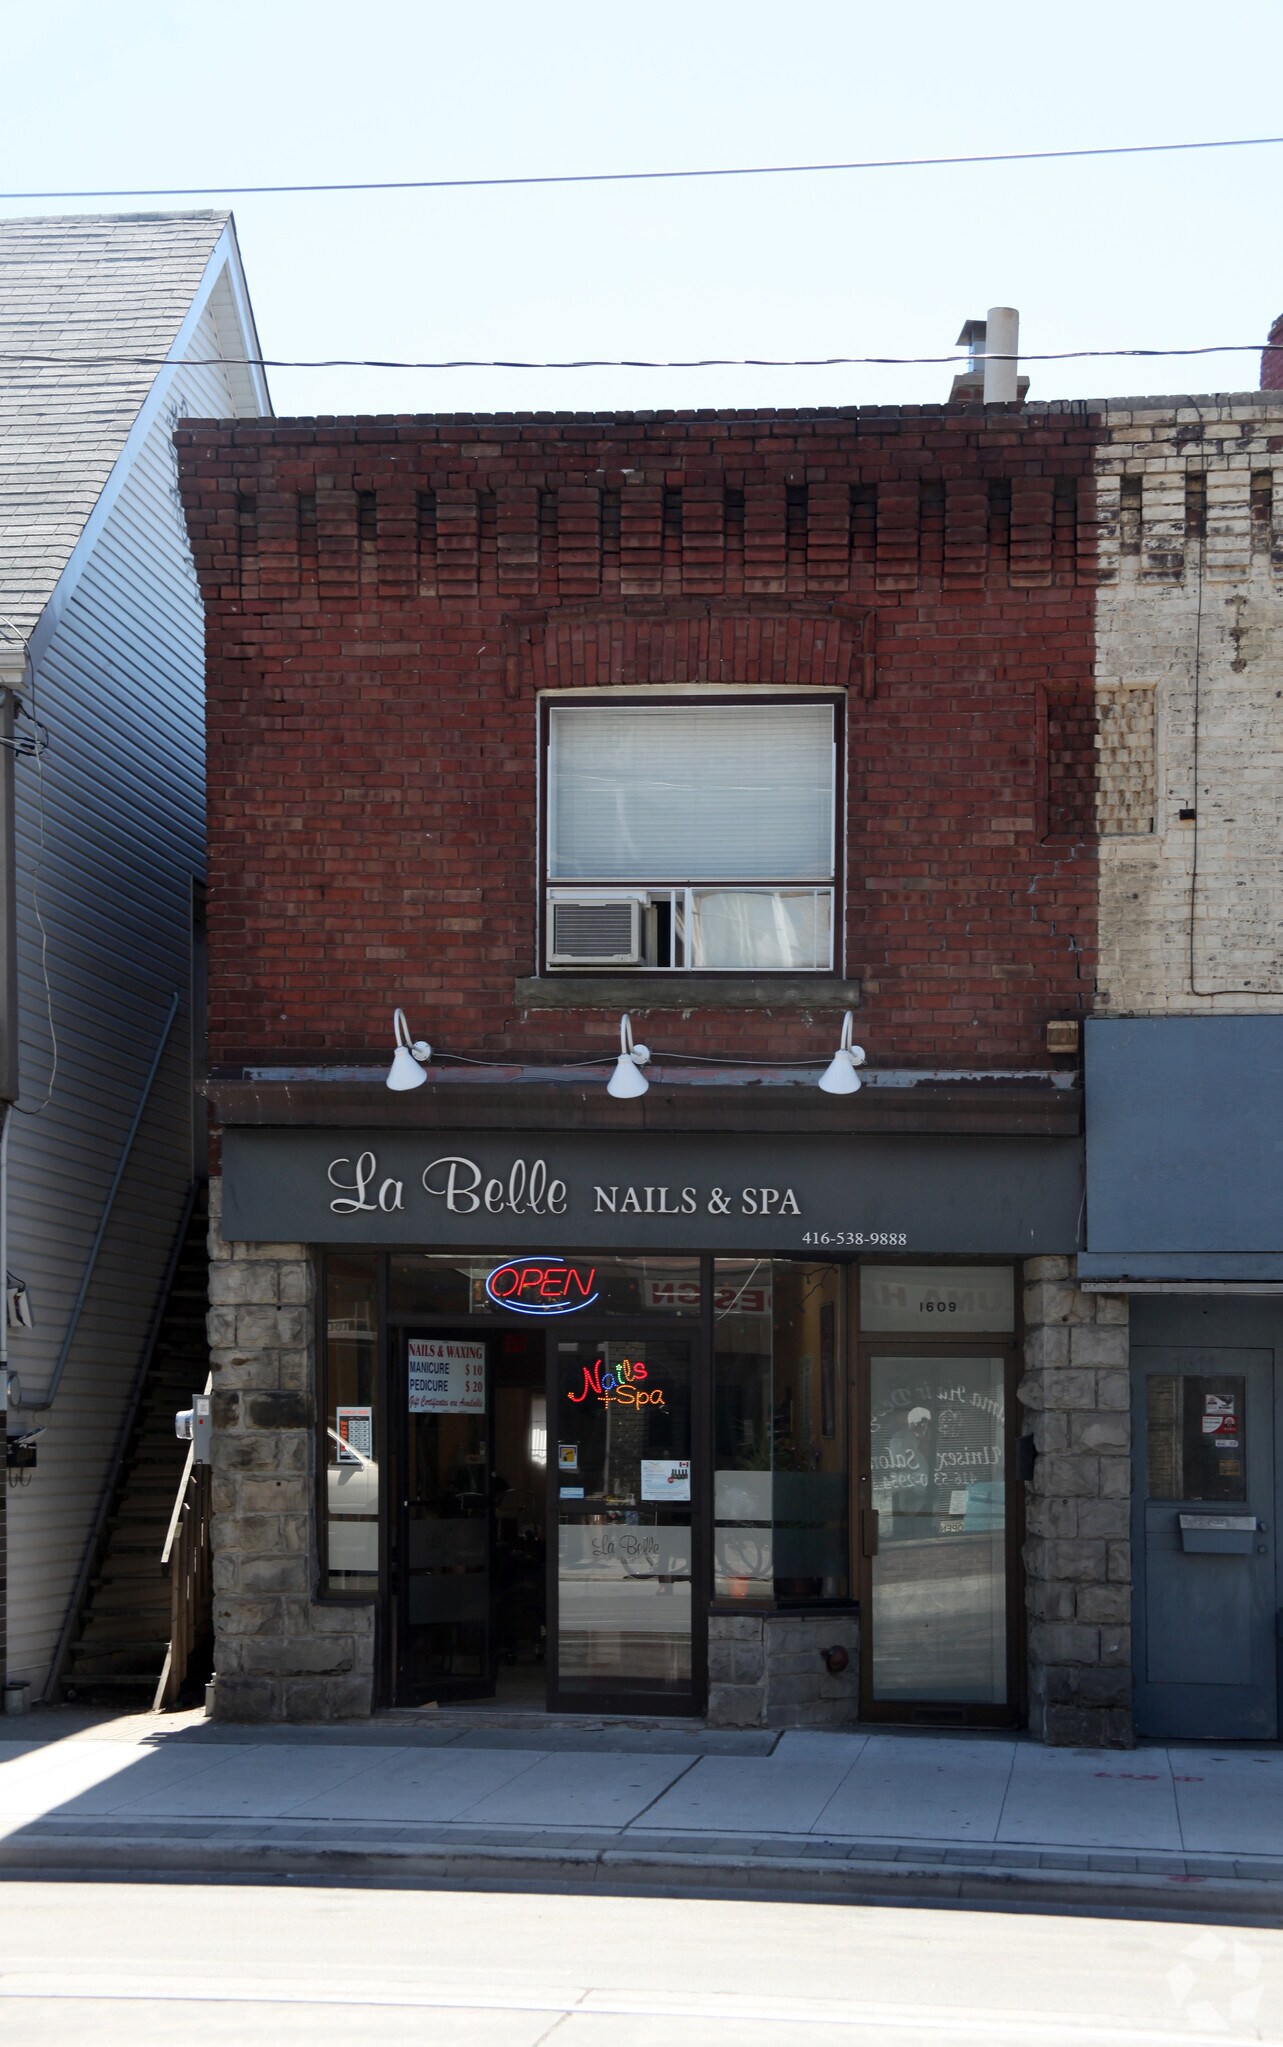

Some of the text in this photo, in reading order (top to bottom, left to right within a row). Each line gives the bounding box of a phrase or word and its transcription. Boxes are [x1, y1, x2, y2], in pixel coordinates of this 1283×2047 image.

[328, 1151, 802, 1215] La Belle NAILS & SPA
[802, 1231, 907, 1246] 416-538-9888
[491, 1268, 596, 1297] OPEN
[920, 1302, 957, 1313] 1609
[408, 1344, 483, 1360] NAILS & WAXING
[409, 1361, 450, 1375] MANICURE
[473, 1365, 483, 1376] 10
[409, 1379, 449, 1392] PEDICURE
[472, 1381, 483, 1393] 20
[567, 1359, 649, 1403] Nails
[592, 1535, 615, 1555] La
